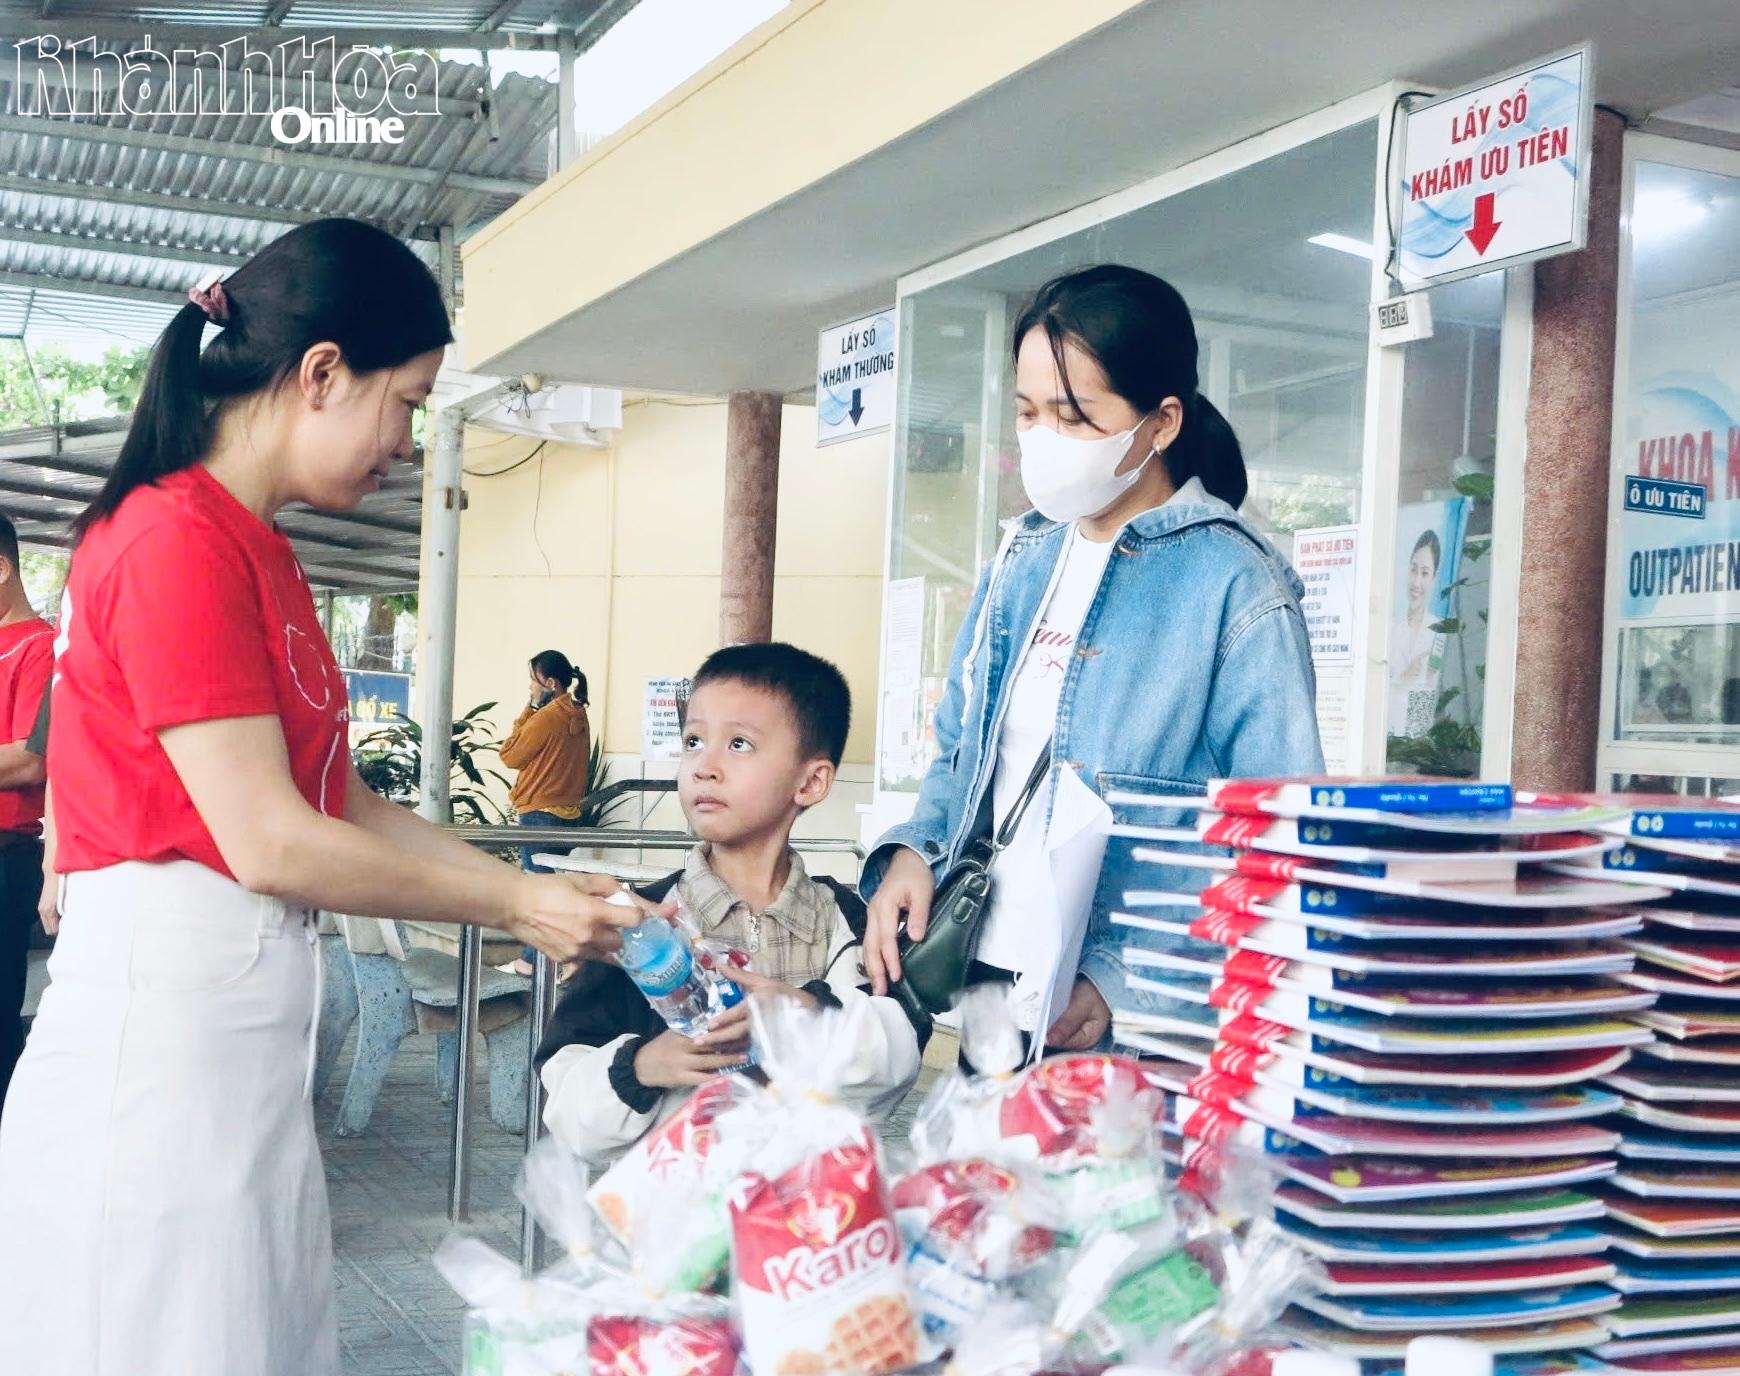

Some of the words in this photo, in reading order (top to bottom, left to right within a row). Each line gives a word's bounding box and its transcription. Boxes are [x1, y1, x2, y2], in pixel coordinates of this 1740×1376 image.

[1451, 99, 1492, 145] LẤY
[1497, 82, 1529, 129] SỐ
[1411, 157, 1473, 202] KHÁM
[1480, 145, 1510, 181] ƯU
[1517, 126, 1569, 169] TIÊN
[1630, 483, 1641, 504] Ô
[1645, 487, 1665, 507] ƯU
[1668, 489, 1701, 512] TIÊN
[1638, 430, 1714, 502] KHOA
[767, 1225, 890, 1303] Karo
